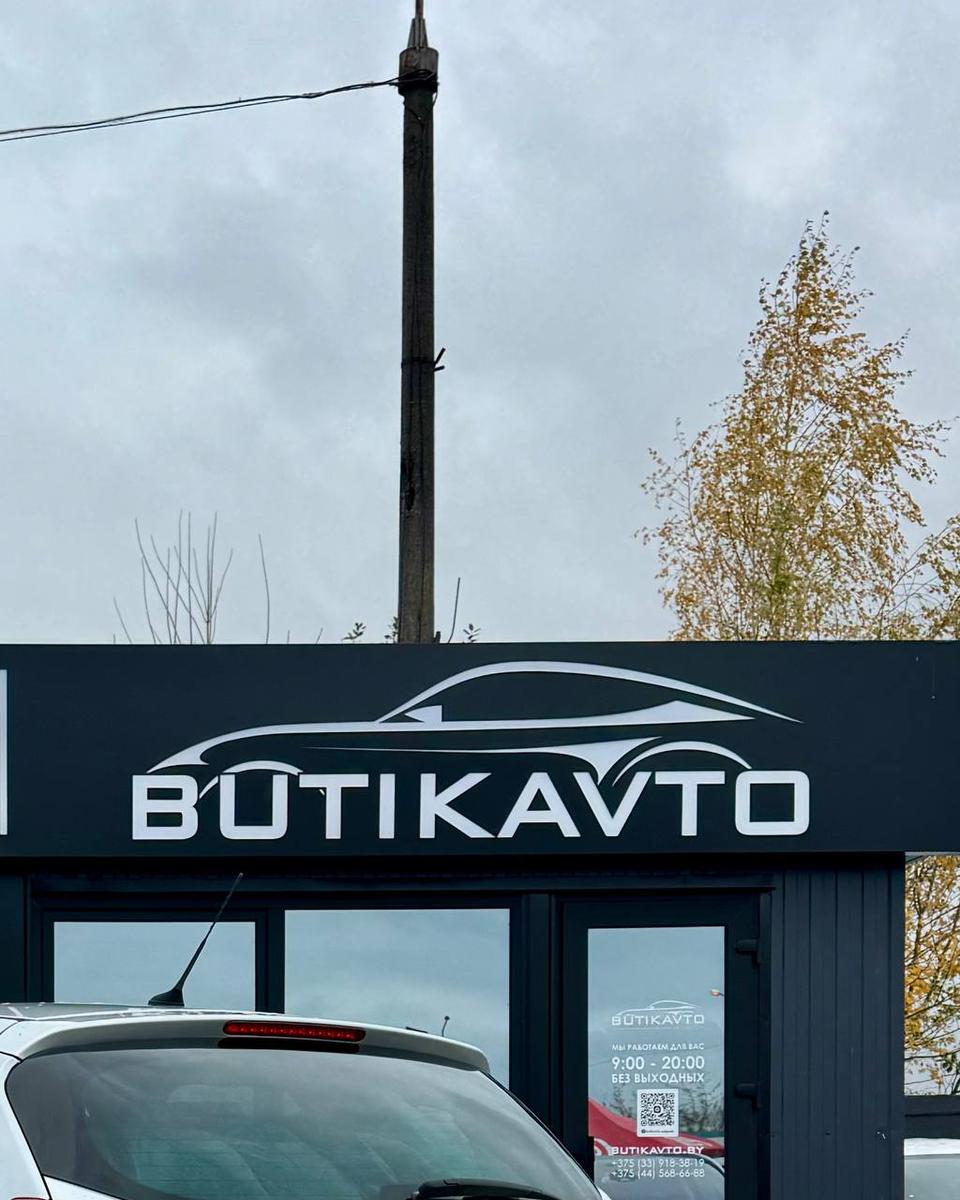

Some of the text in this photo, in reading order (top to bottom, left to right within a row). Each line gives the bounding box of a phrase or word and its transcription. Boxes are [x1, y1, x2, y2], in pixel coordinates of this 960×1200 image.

[131, 769, 810, 841] BUTIKAVTO
[612, 1014, 705, 1026] BUTIKAVTO
[612, 1056, 645, 1070] 9:00
[662, 1056, 705, 1069] 20:00
[612, 1073, 705, 1084] БЕЗ ВЫХОДНЫХ
[611, 1146, 705, 1155] BUTIKAVTO.BY
[612, 1158, 705, 1170] +375 (33) 918-38-19
[612, 1168, 705, 1180] +375 (44) 568-66-88
